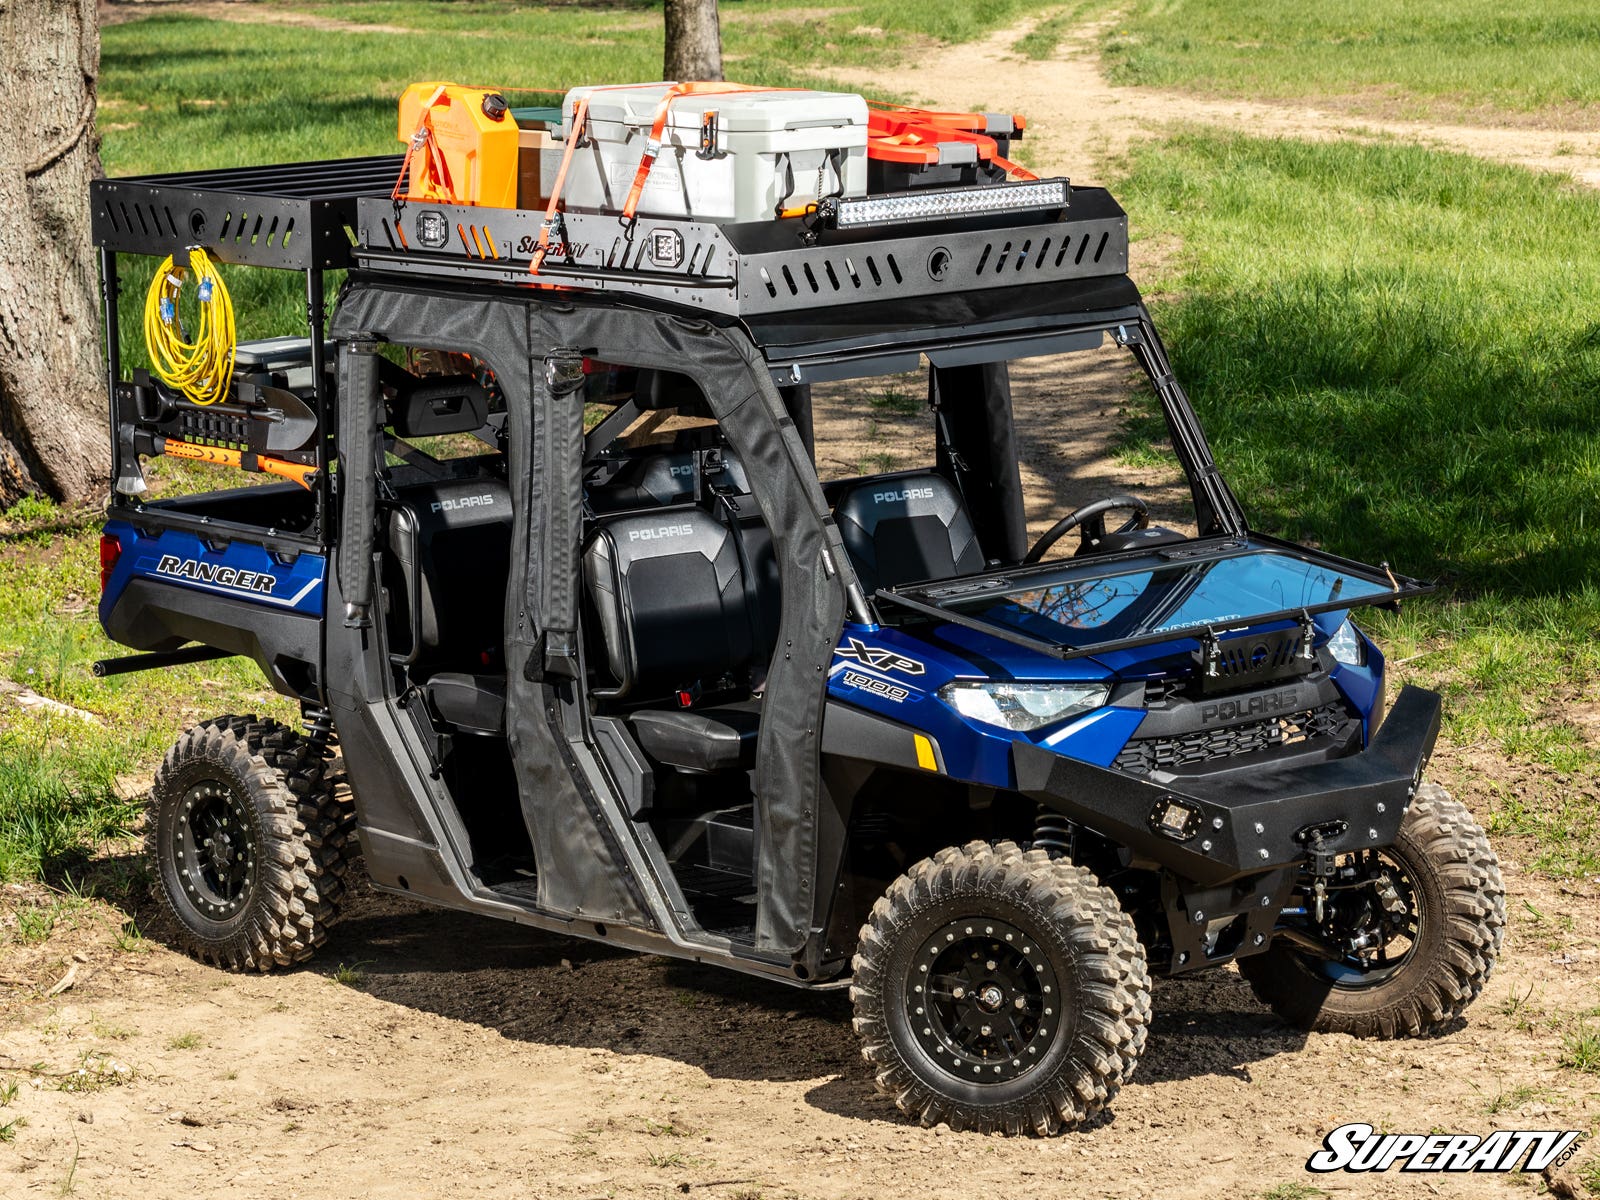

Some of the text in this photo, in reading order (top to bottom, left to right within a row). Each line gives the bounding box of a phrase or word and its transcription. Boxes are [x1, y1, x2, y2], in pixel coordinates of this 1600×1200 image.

[430, 494, 494, 513] POLARIS
[873, 488, 934, 504] POLARIS
[628, 524, 694, 542] POLARIS
[156, 554, 276, 593] RANGER
[833, 636, 926, 675] XP
[843, 670, 909, 700] 1000
[1201, 688, 1298, 724] POLARIS
